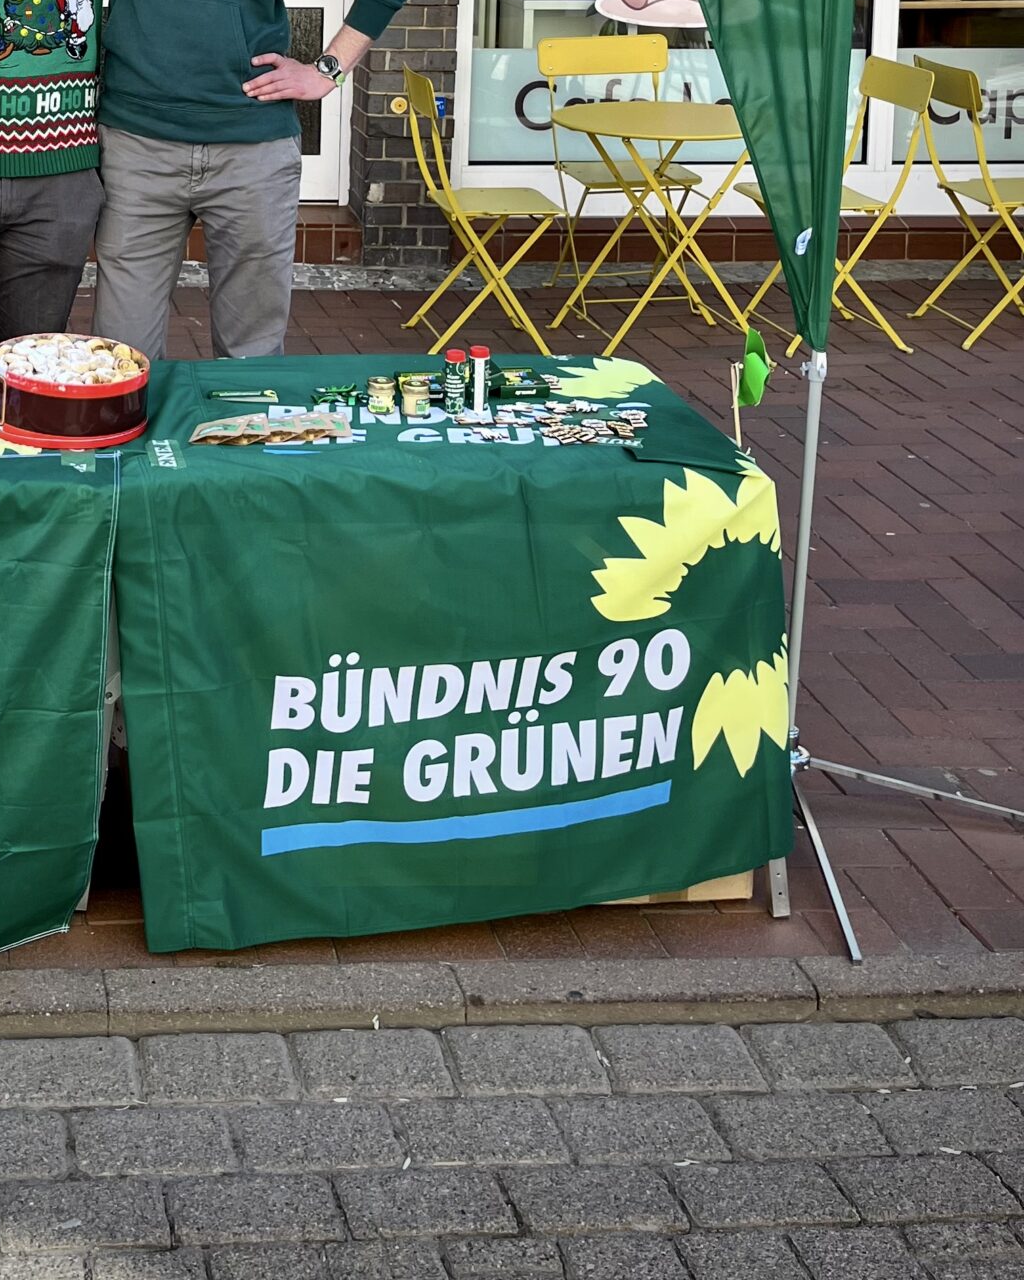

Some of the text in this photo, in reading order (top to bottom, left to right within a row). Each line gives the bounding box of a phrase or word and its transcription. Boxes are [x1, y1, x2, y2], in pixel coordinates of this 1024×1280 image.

[270, 628, 692, 734] BÜNDNIS 90
[263, 708, 684, 809] DIE GRÜNEN
